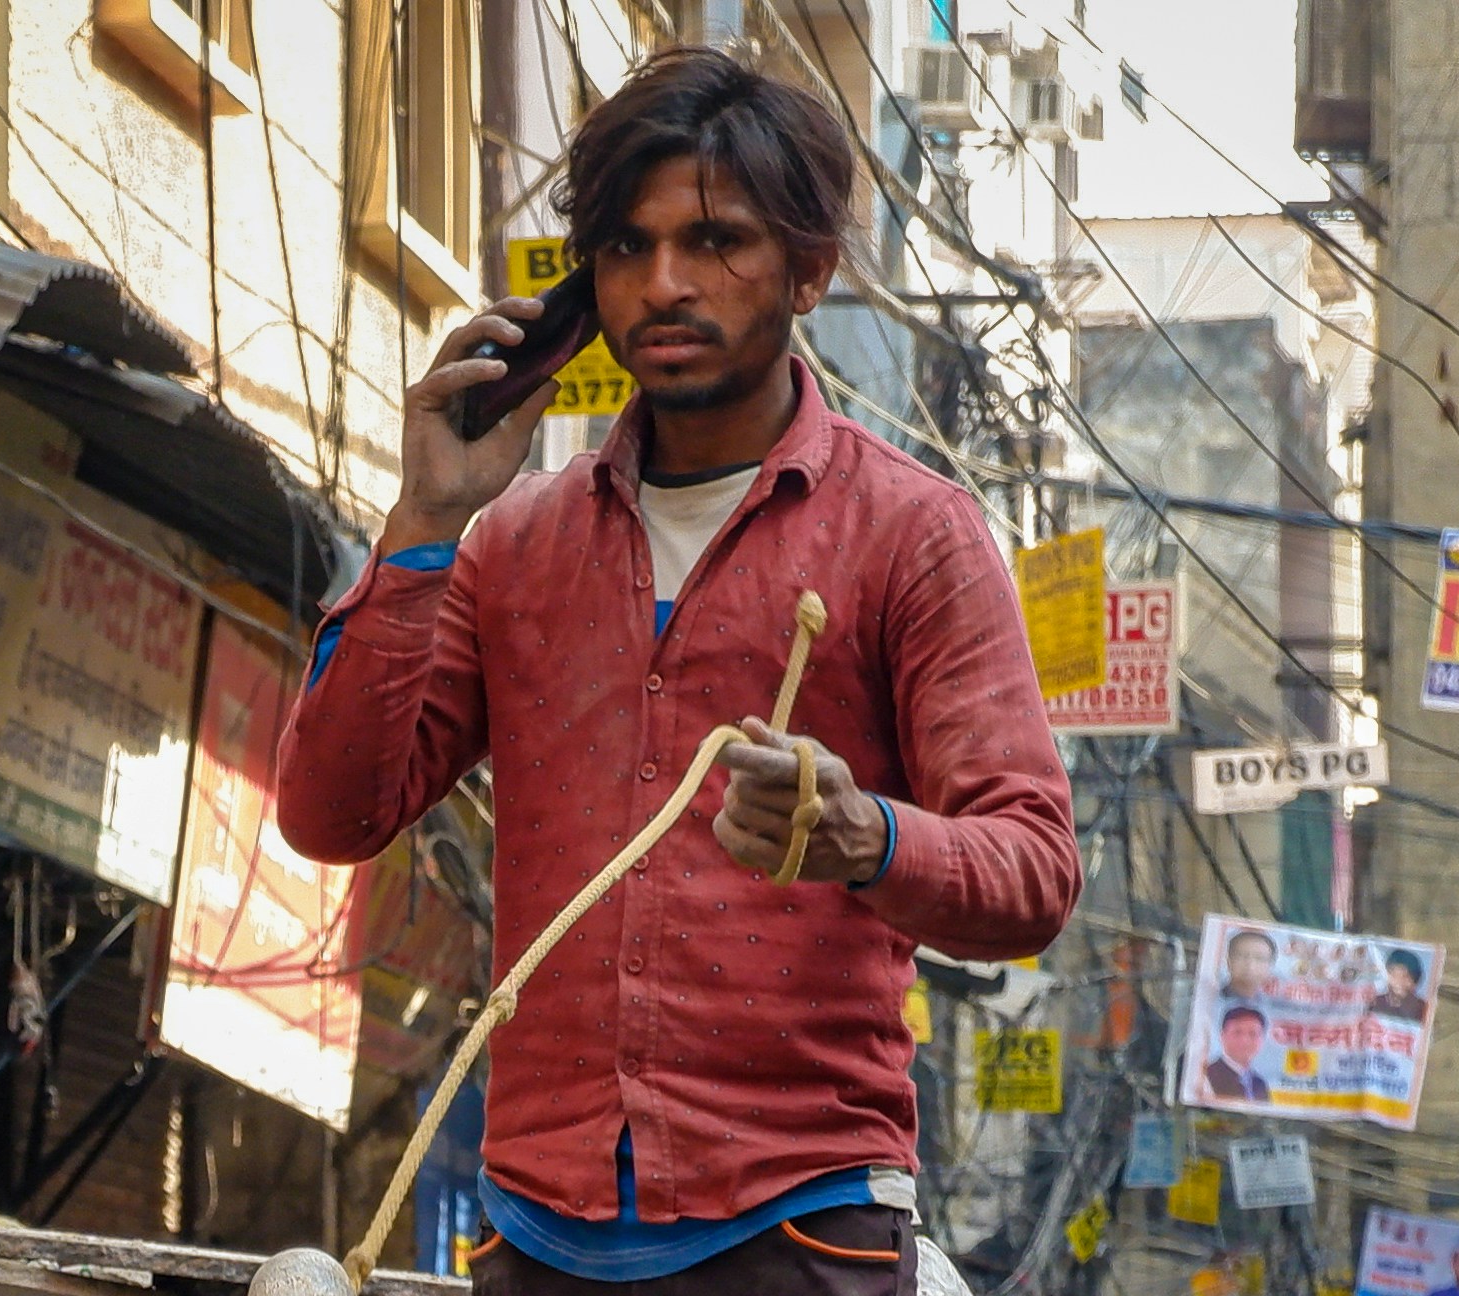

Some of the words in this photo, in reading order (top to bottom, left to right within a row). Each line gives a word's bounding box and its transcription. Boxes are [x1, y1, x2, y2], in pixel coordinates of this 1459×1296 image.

[1119, 596, 1168, 641] PG
[1213, 749, 1311, 787] BOYS
[1322, 748, 1371, 780] PG
